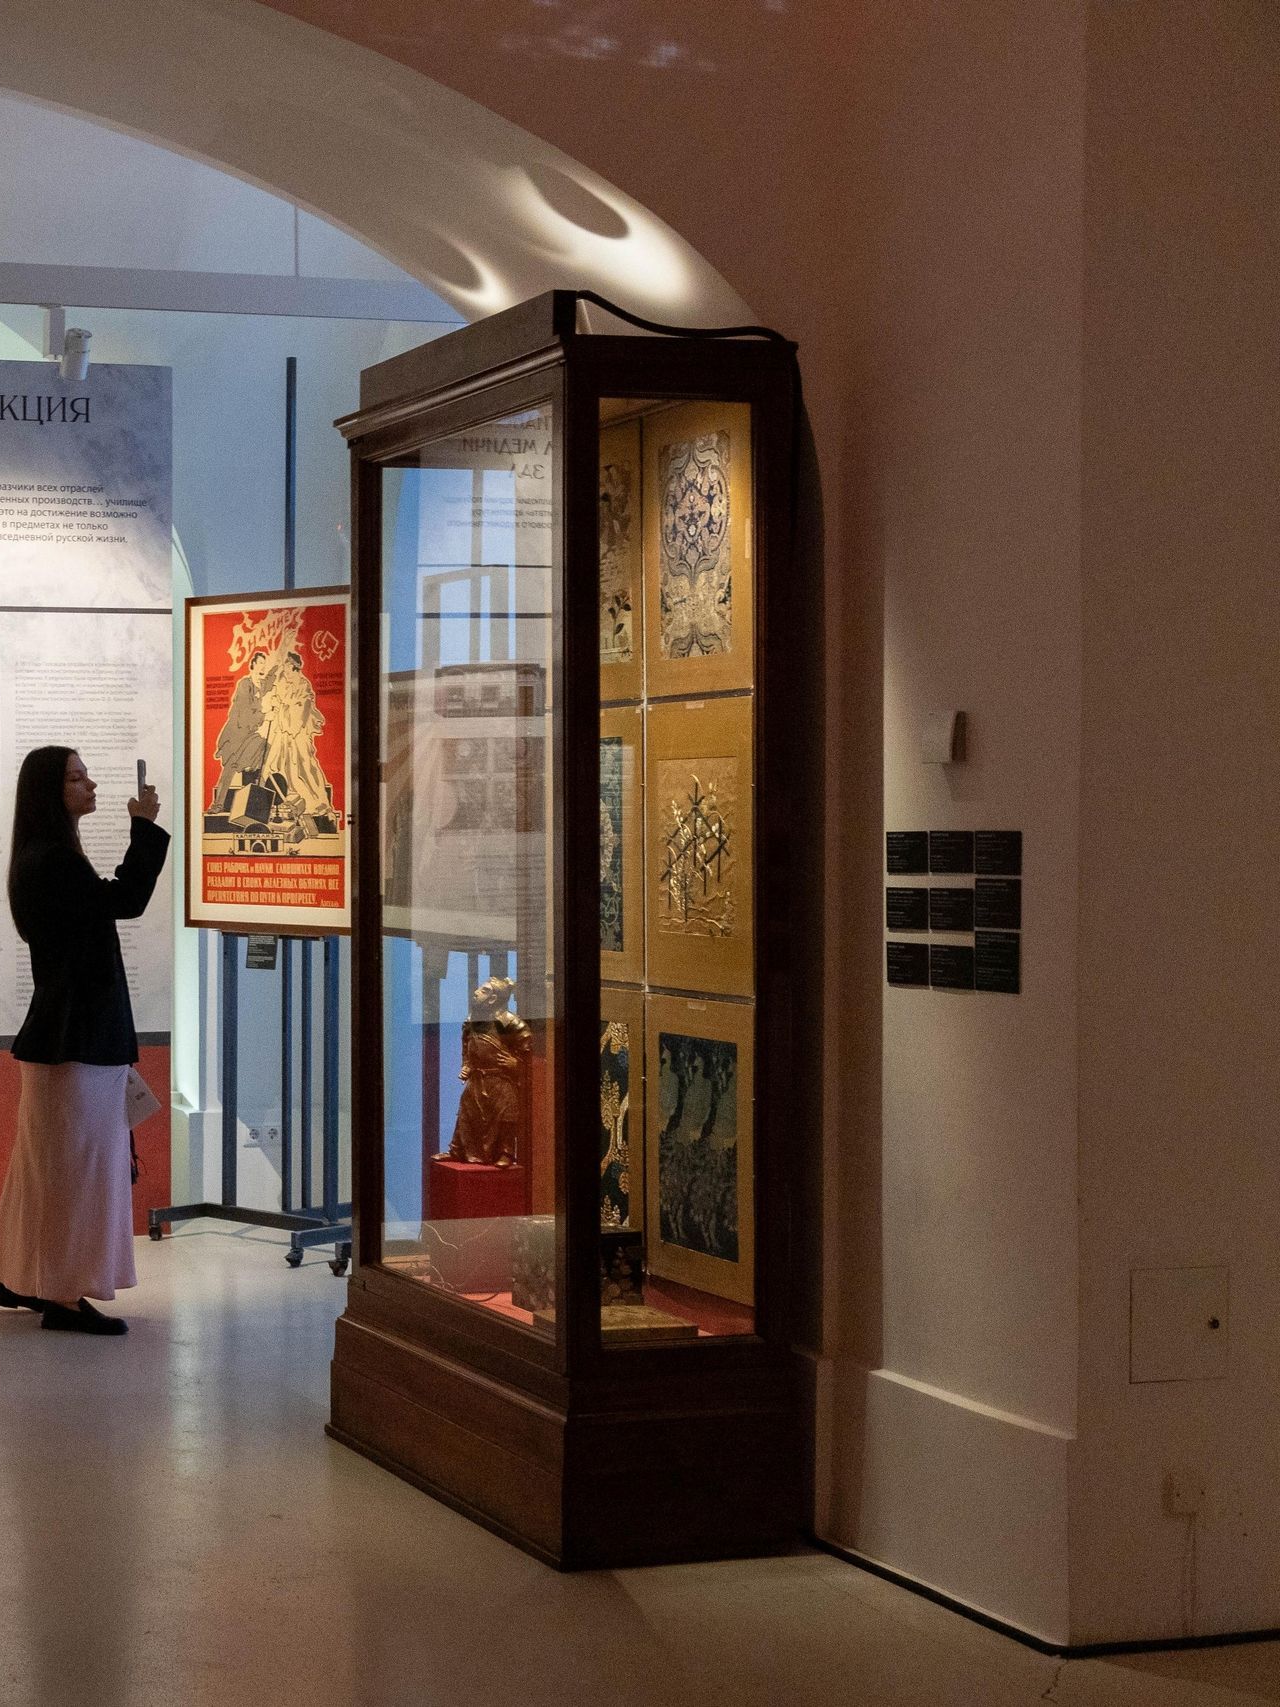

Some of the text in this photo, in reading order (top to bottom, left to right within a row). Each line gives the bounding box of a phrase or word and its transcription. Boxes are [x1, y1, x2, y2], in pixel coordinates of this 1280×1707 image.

[37, 484, 58, 492] всех
[60, 484, 104, 494] отраслей
[105, 499, 148, 508] училище
[0, 508, 15, 516] это
[30, 509, 88, 518] достижение
[90, 511, 138, 519] возможно
[9, 521, 60, 530] предметах
[76, 523, 109, 531] только
[56, 534, 93, 544] русской
